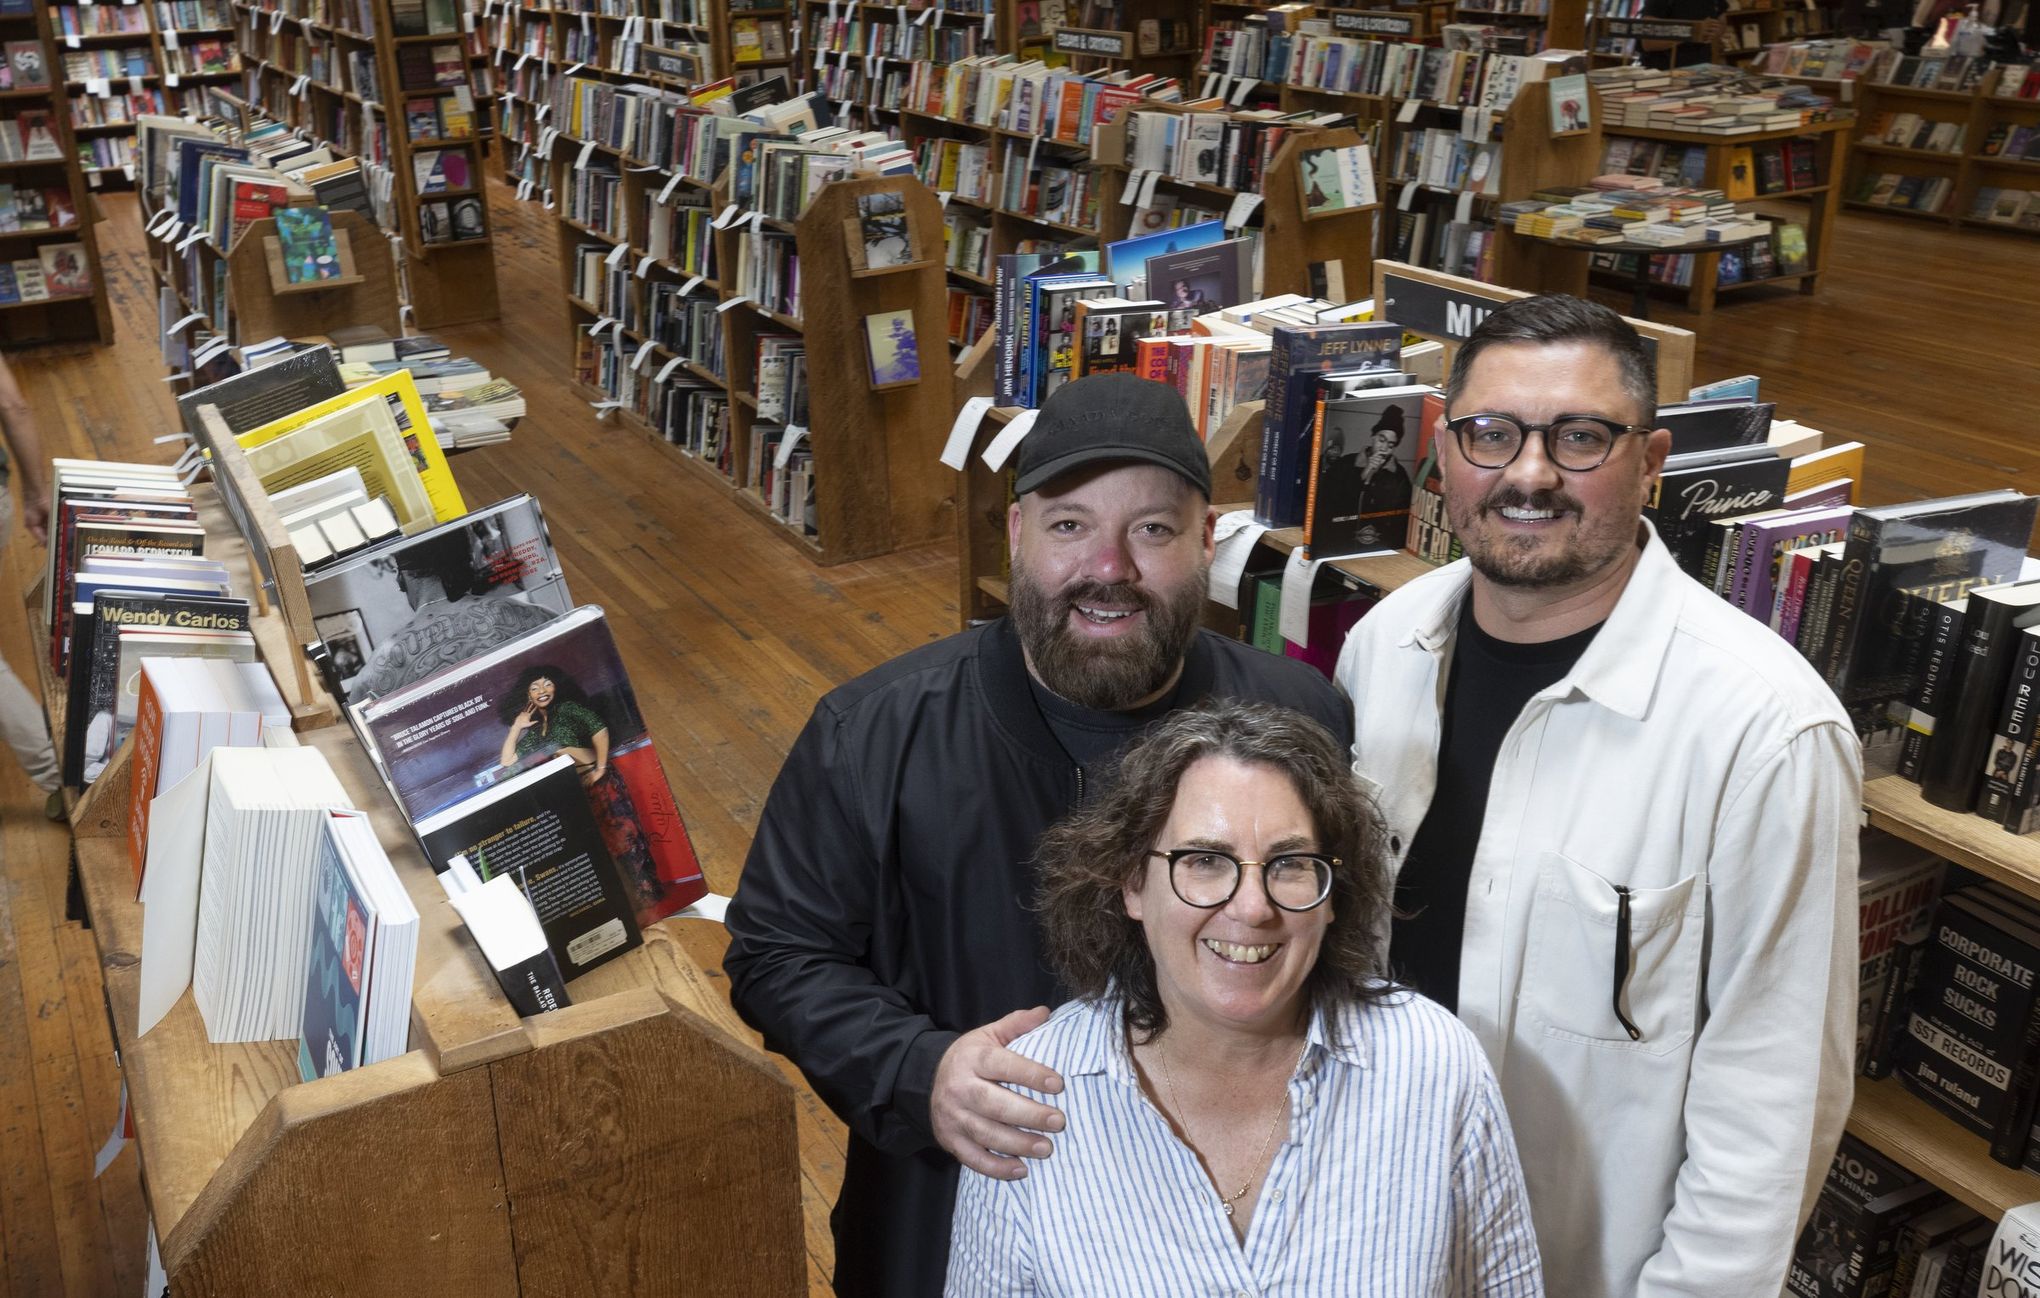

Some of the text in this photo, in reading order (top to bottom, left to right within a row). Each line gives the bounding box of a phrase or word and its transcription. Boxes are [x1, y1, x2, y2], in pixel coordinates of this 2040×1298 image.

[1004, 334, 1014, 376] HENDRIX
[1316, 338, 1393, 357] JEFF LYNNE
[1003, 377, 1013, 397] JIMI
[1680, 479, 1773, 520] Prince
[1723, 529, 1743, 595] Creative Quest
[1831, 555, 1866, 620] QUEEN
[103, 606, 240, 630] Wendy Carlos
[1920, 615, 1953, 705] OTIS REDDING
[402, 735, 413, 745] THE
[411, 728, 430, 740] GLORY
[428, 720, 446, 733] YEARS
[444, 717, 453, 726] OF
[450, 712, 465, 722] SOUL
[463, 706, 476, 717] AND
[409, 717, 434, 733] TALAMON
[431, 705, 459, 722] CAPTURED
[457, 698, 475, 711] BLACK
[473, 694, 484, 704] JOY
[2007, 683, 2032, 735] REED
[476, 829, 505, 848] stranger
[512, 814, 537, 831] failure,
[534, 864, 559, 881] Swans,
[1939, 925, 2035, 988] CORPORATE
[527, 971, 548, 1009] THE BALLAD
[1954, 963, 1999, 998] ROCK
[1943, 986, 1997, 1027] SUCKS
[1913, 1021, 1938, 1044] SST
[1942, 1037, 2006, 1085] RECORDS
[1918, 1061, 1981, 1109] jim ruland
[1848, 1250, 1864, 1278] RAP
